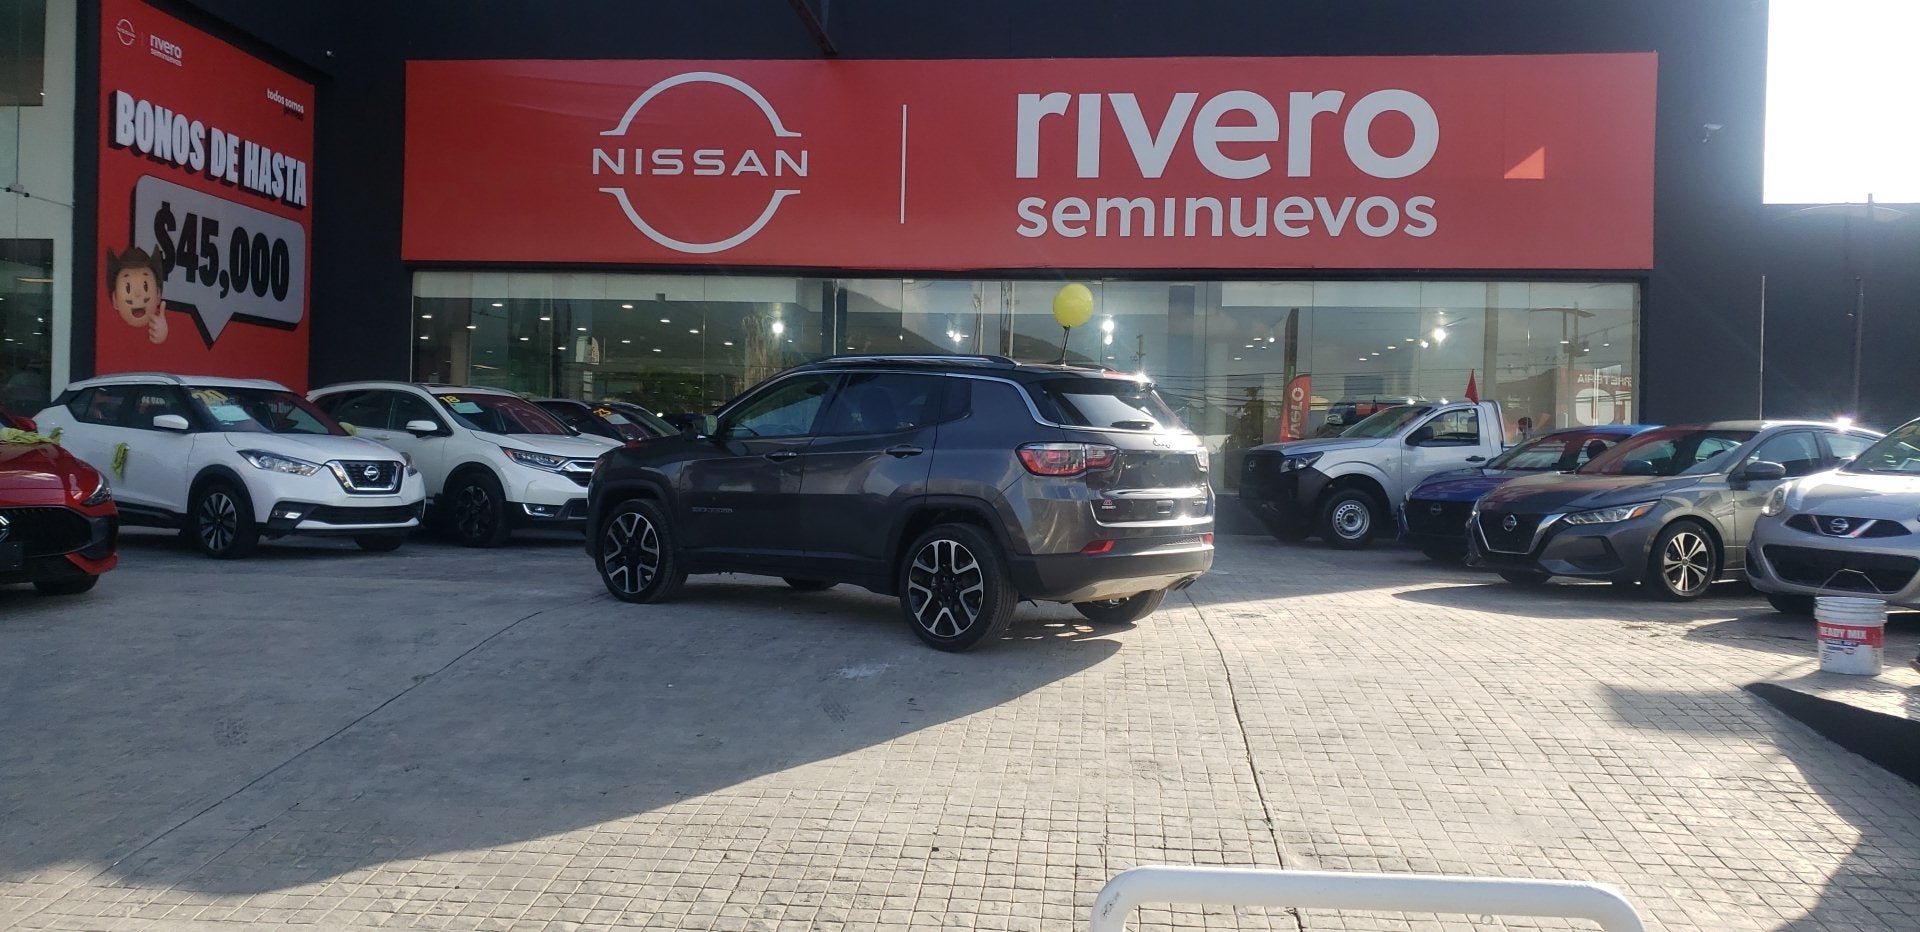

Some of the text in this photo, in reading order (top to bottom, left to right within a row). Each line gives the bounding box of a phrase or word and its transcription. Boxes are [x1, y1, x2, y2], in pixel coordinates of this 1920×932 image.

[150, 34, 183, 59] rivero
[267, 88, 285, 105] todos
[284, 98, 305, 114] somos
[116, 90, 307, 207] BONOS DE HASTA
[1015, 88, 1440, 180] rivero
[592, 148, 808, 177] NISSAN
[1016, 195, 1438, 238] seminuevos
[154, 201, 290, 301] $45,000
[438, 395, 461, 404] 18
[1847, 629, 1868, 640] MIX
